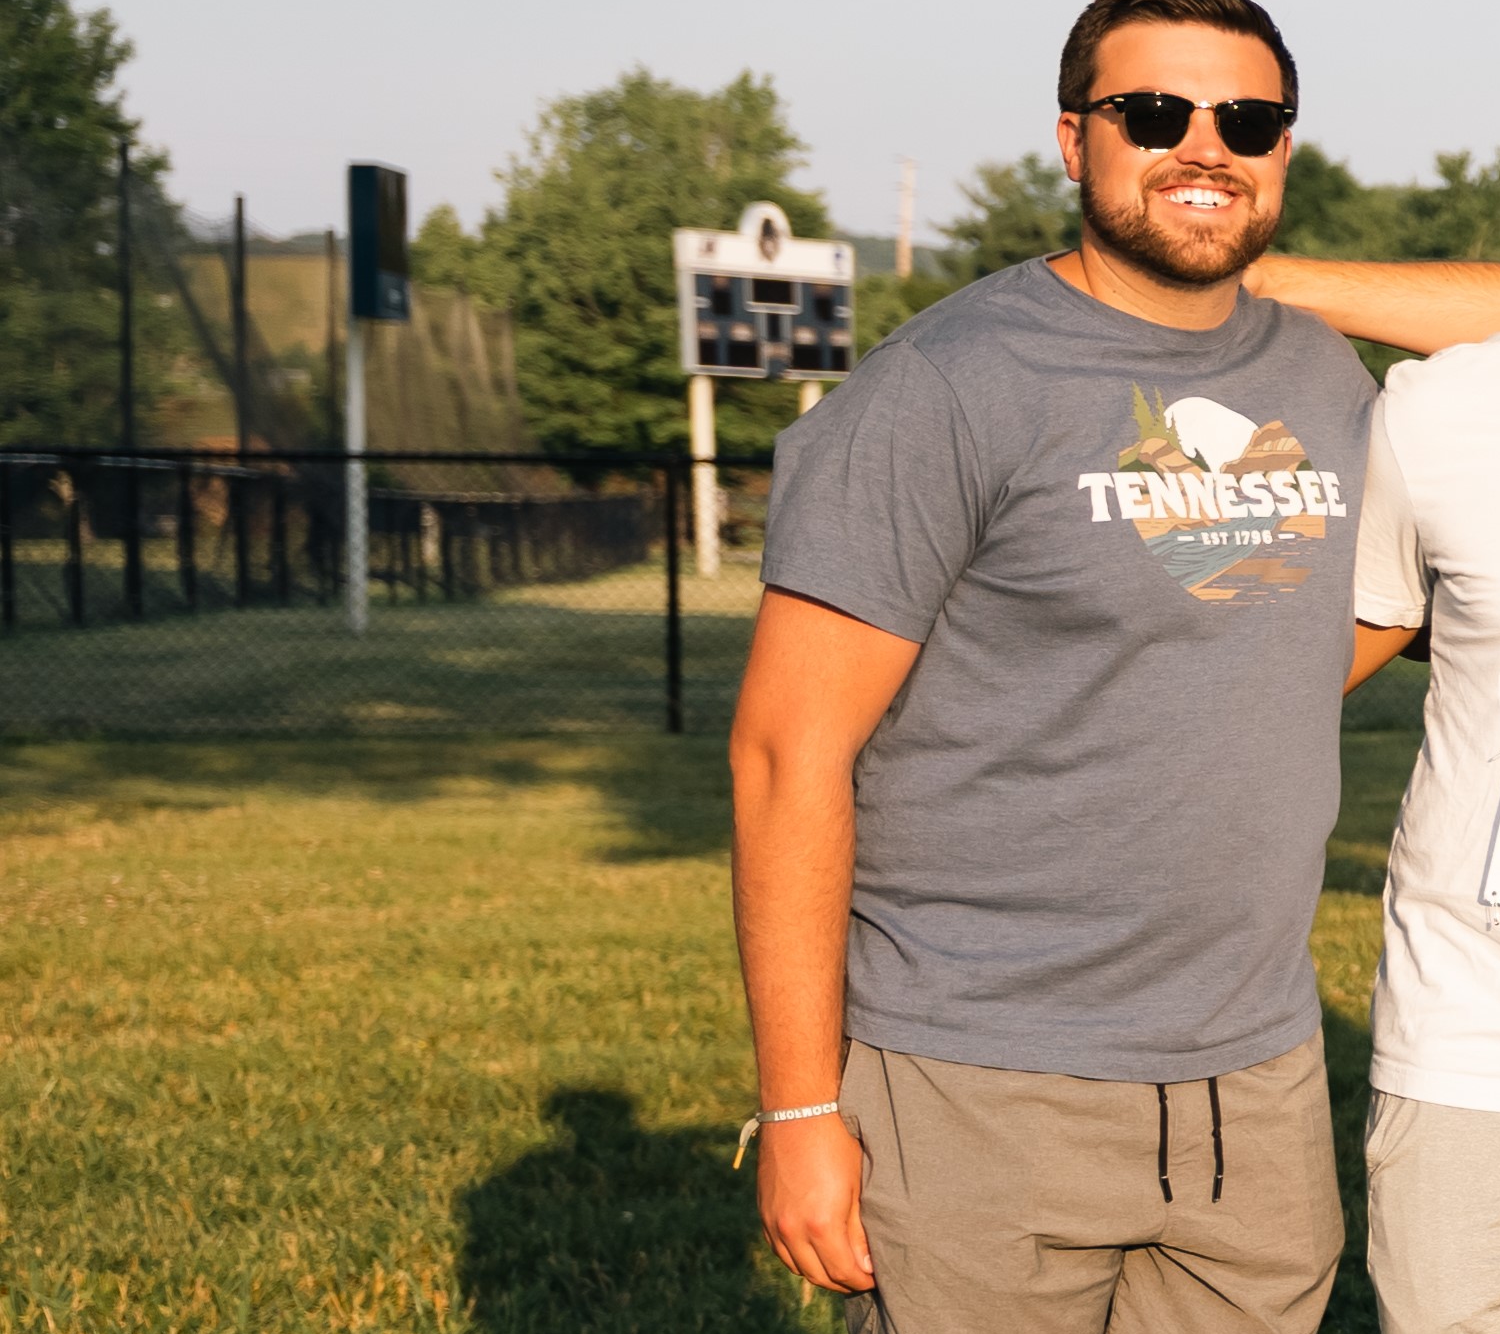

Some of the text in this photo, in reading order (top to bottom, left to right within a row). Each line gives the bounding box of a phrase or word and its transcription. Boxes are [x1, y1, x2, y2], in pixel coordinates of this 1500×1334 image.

[1077, 470, 1347, 523] TENNESSEE
[1200, 529, 1274, 546] EST 1796
